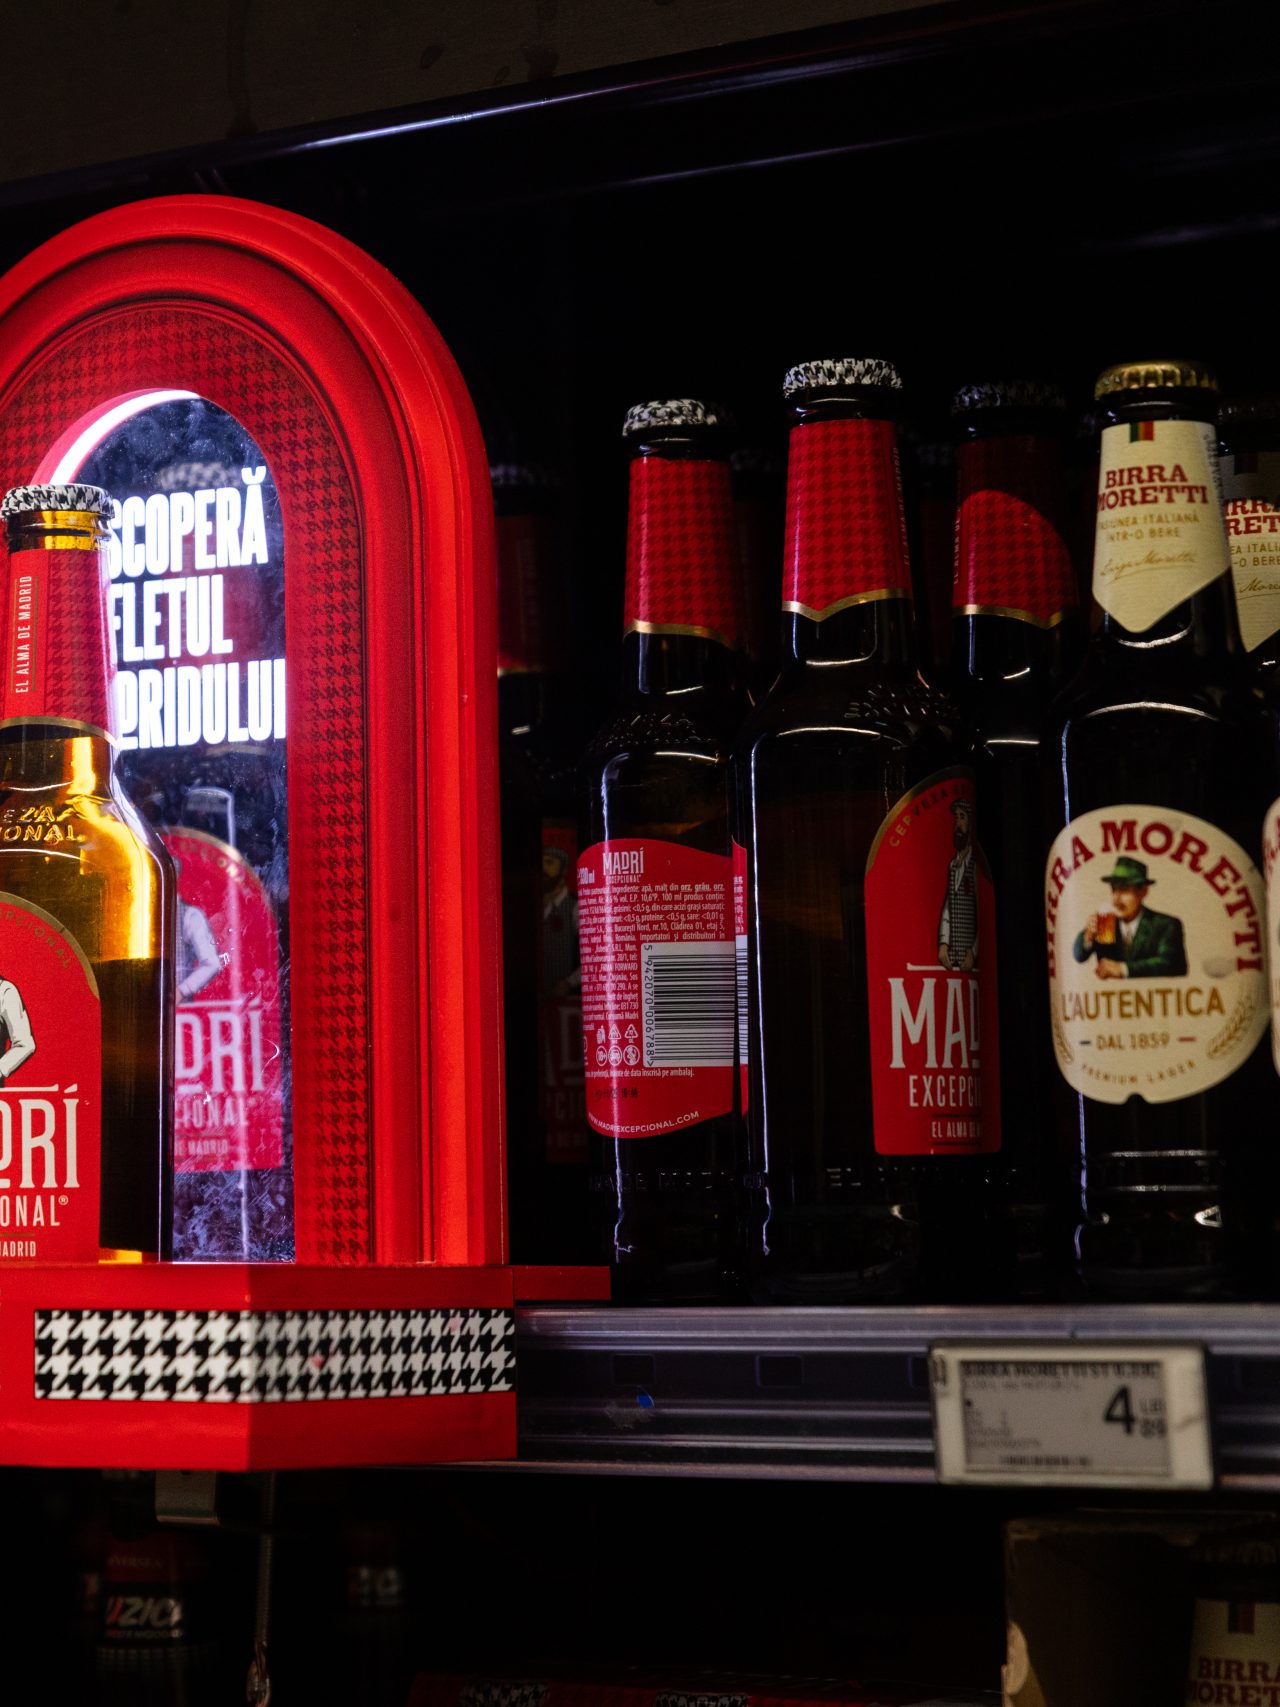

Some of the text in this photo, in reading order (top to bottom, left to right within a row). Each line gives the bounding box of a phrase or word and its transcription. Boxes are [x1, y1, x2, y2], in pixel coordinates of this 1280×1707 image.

[1105, 464, 1188, 489] BIRRA
[16, 575, 32, 693] EL ALMA DE MADRID
[602, 848, 644, 876] MADRÍ
[1100, 820, 1263, 972] MORETTI
[1061, 986, 1226, 1023] L'AUTENTICA
[931, 1121, 943, 1138] EL
[1104, 1384, 1136, 1436] 4
